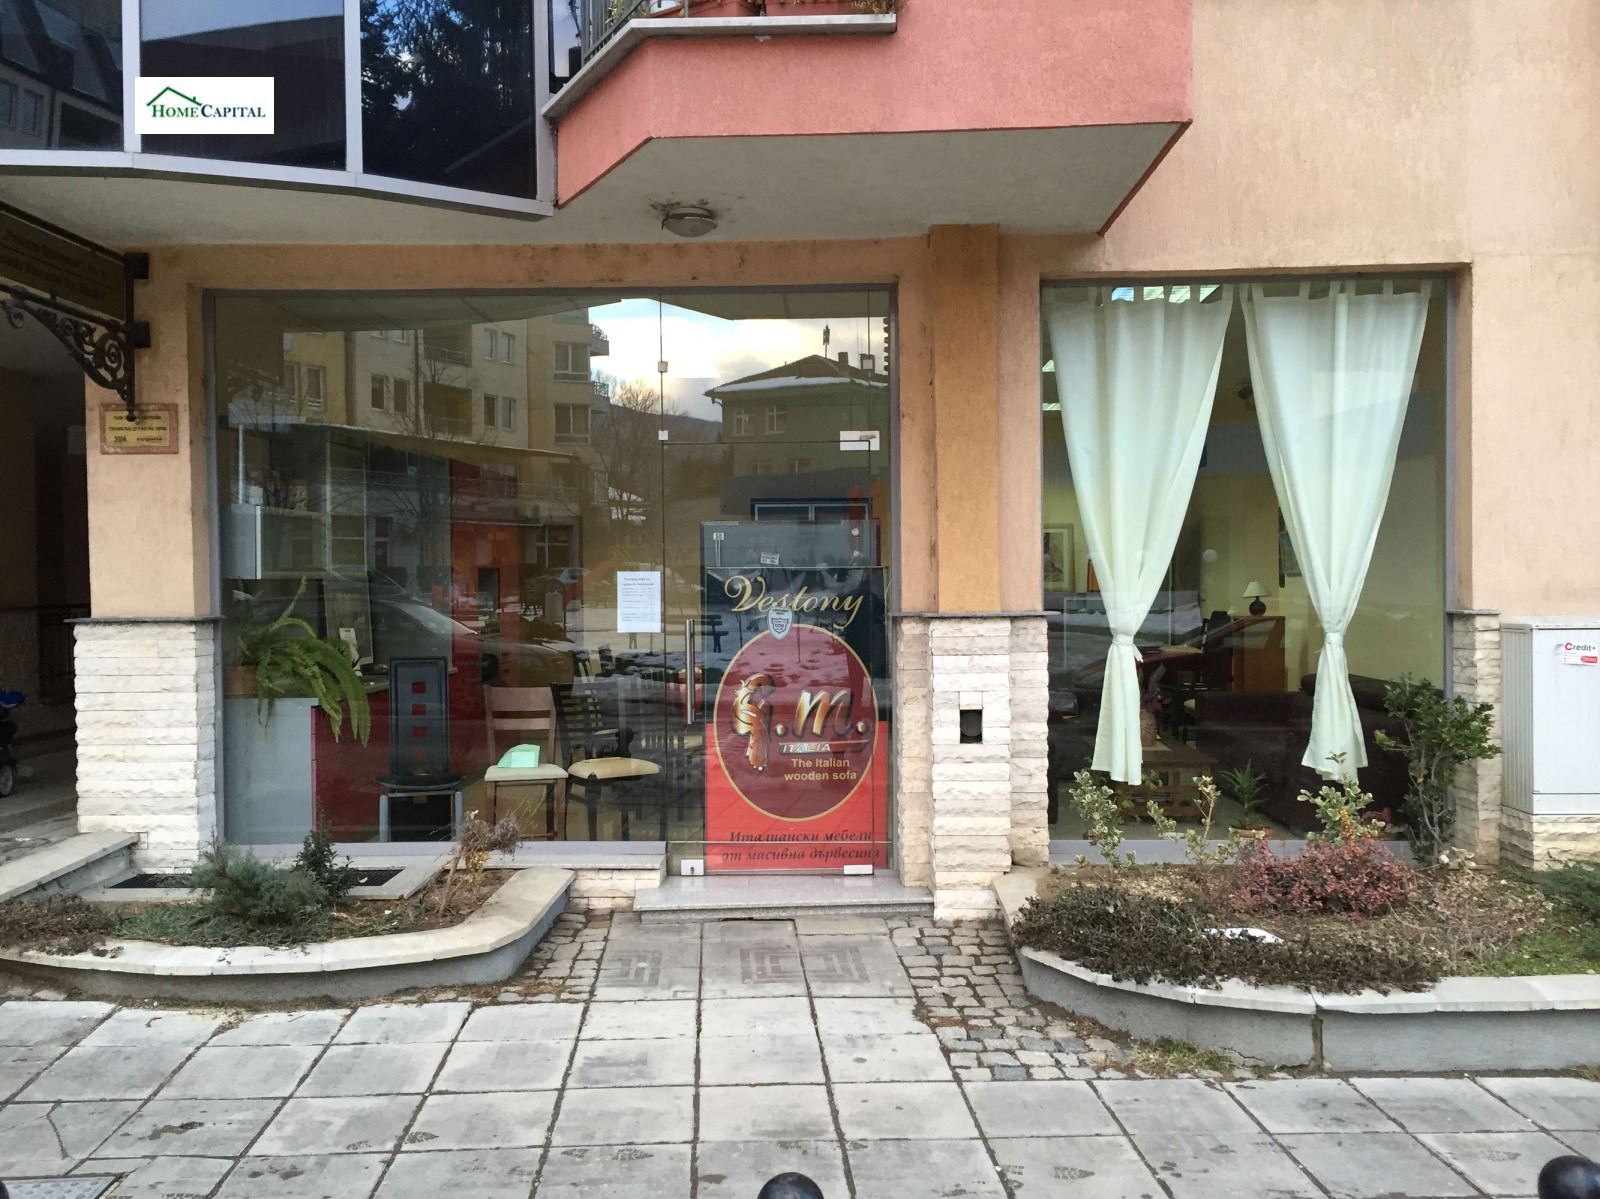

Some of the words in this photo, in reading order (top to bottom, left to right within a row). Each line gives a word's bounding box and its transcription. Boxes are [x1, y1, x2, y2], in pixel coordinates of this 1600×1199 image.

[724, 575, 864, 629] Vestony
[782, 743, 831, 753] ITALIA
[791, 758, 812, 768] The
[815, 757, 850, 768] Italian
[784, 771, 829, 781] wooden
[832, 770, 857, 780] sofa
[721, 852, 742, 861] от
[745, 849, 805, 861] масивна
